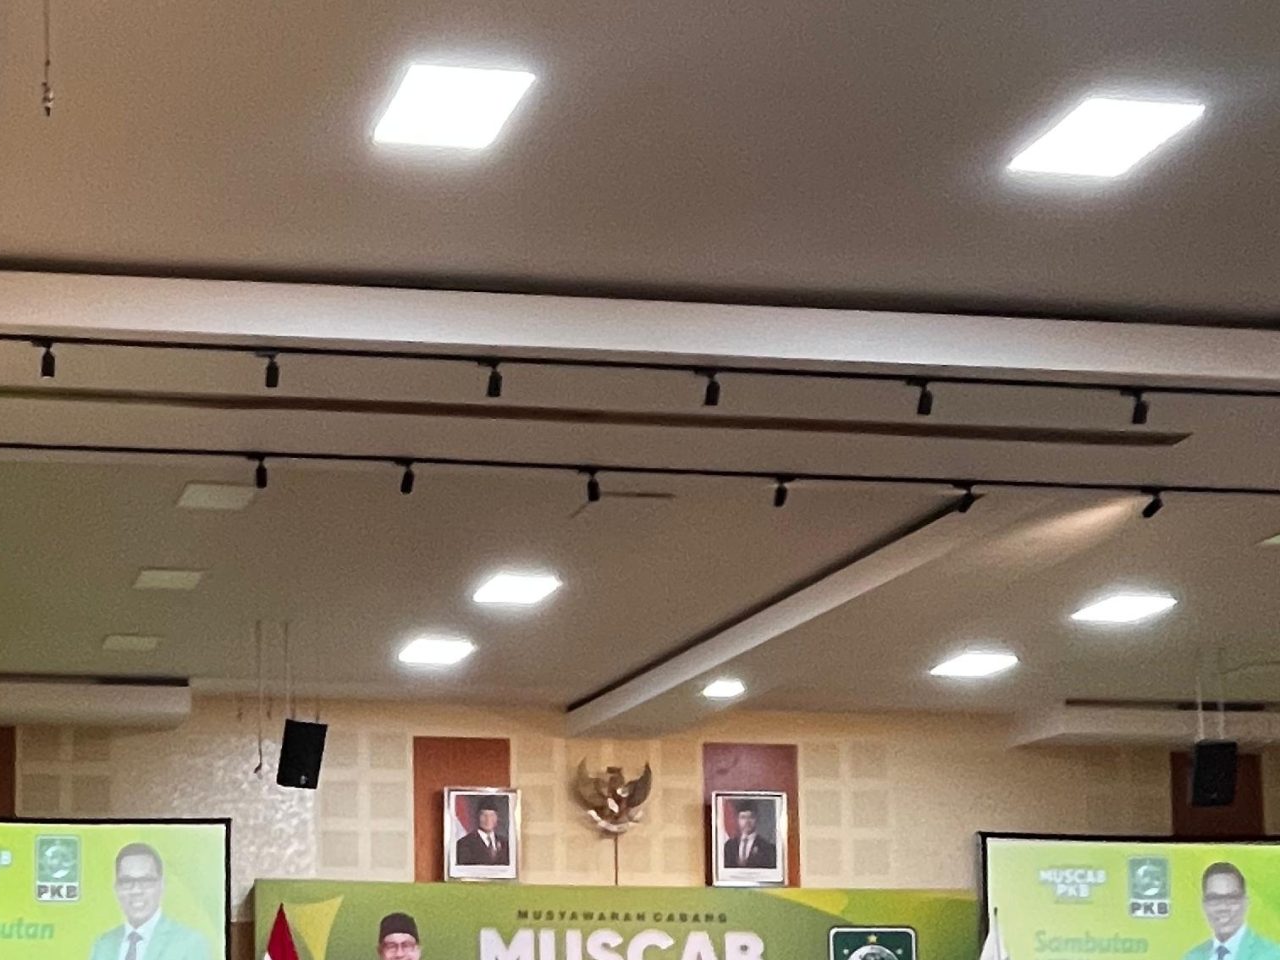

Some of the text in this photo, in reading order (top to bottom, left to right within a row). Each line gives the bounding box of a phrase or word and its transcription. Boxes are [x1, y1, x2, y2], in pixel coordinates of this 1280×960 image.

[37, 885, 78, 899] PKB
[1131, 902, 1169, 915] PKB
[517, 909, 646, 922] MUSYAWARAH
[1034, 930, 1149, 954] Sambutan
